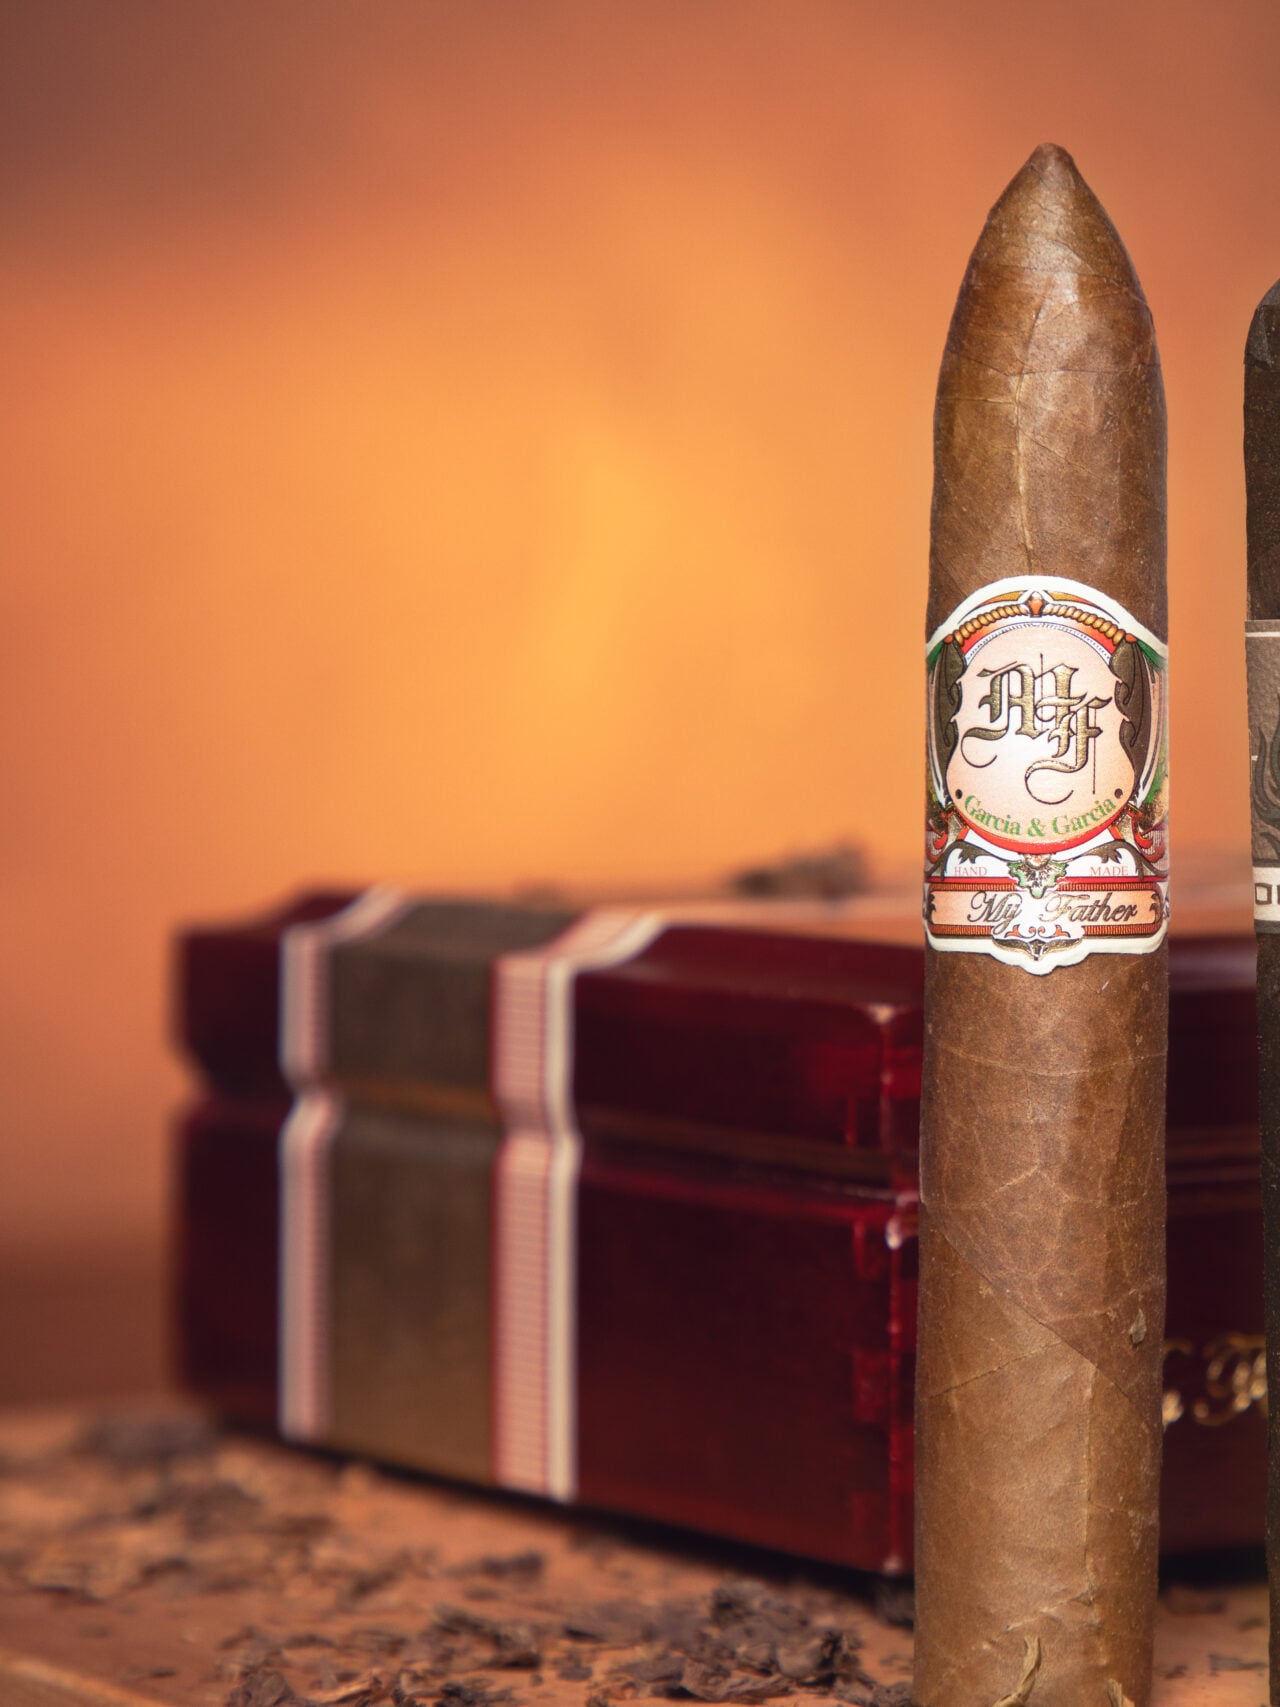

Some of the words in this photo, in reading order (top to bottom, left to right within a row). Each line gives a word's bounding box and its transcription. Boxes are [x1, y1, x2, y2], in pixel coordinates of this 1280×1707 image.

[964, 794, 1022, 837] Garcia
[1027, 817, 1046, 838] &
[1051, 797, 1117, 835] Garcia
[953, 865, 988, 877] HAND
[1090, 865, 1129, 877] MADE
[966, 889, 1023, 934] My
[1038, 892, 1138, 924] Father
